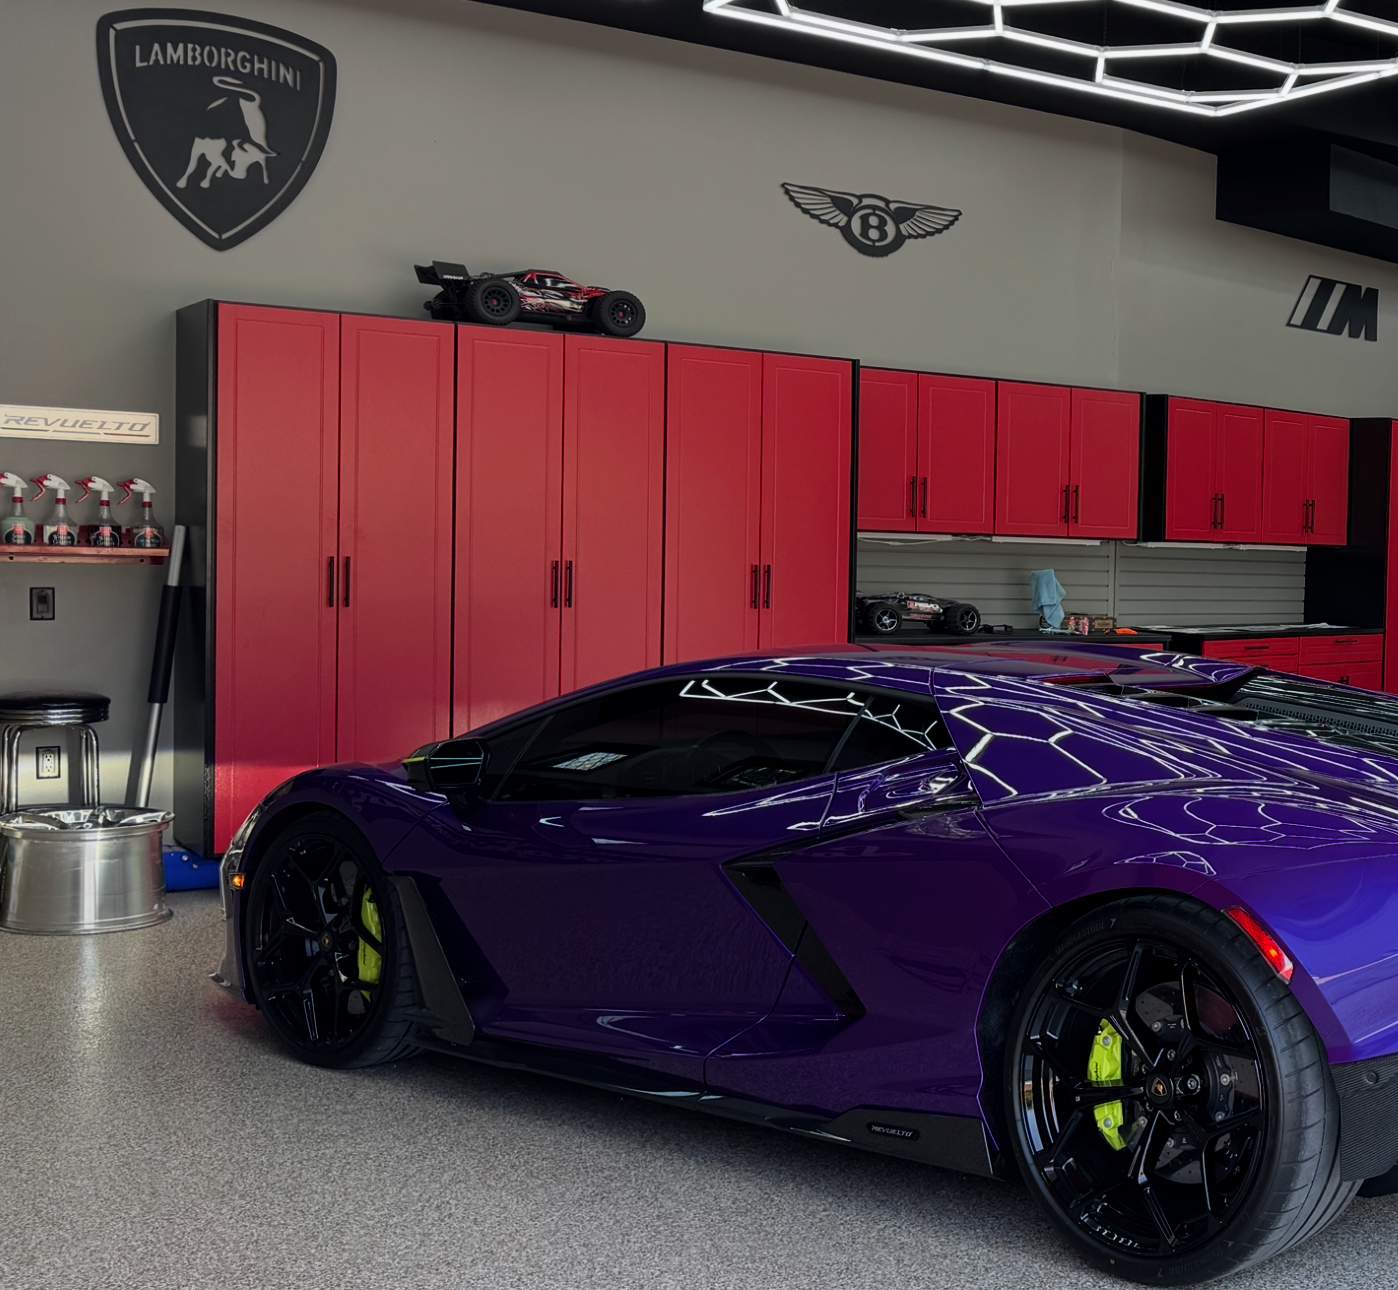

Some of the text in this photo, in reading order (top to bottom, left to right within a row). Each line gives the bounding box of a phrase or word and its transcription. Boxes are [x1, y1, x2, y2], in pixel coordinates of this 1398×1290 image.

[134, 42, 301, 91] LAMBORGHINI
[859, 212, 889, 243] B
[3, 413, 152, 432] REVUELTO
